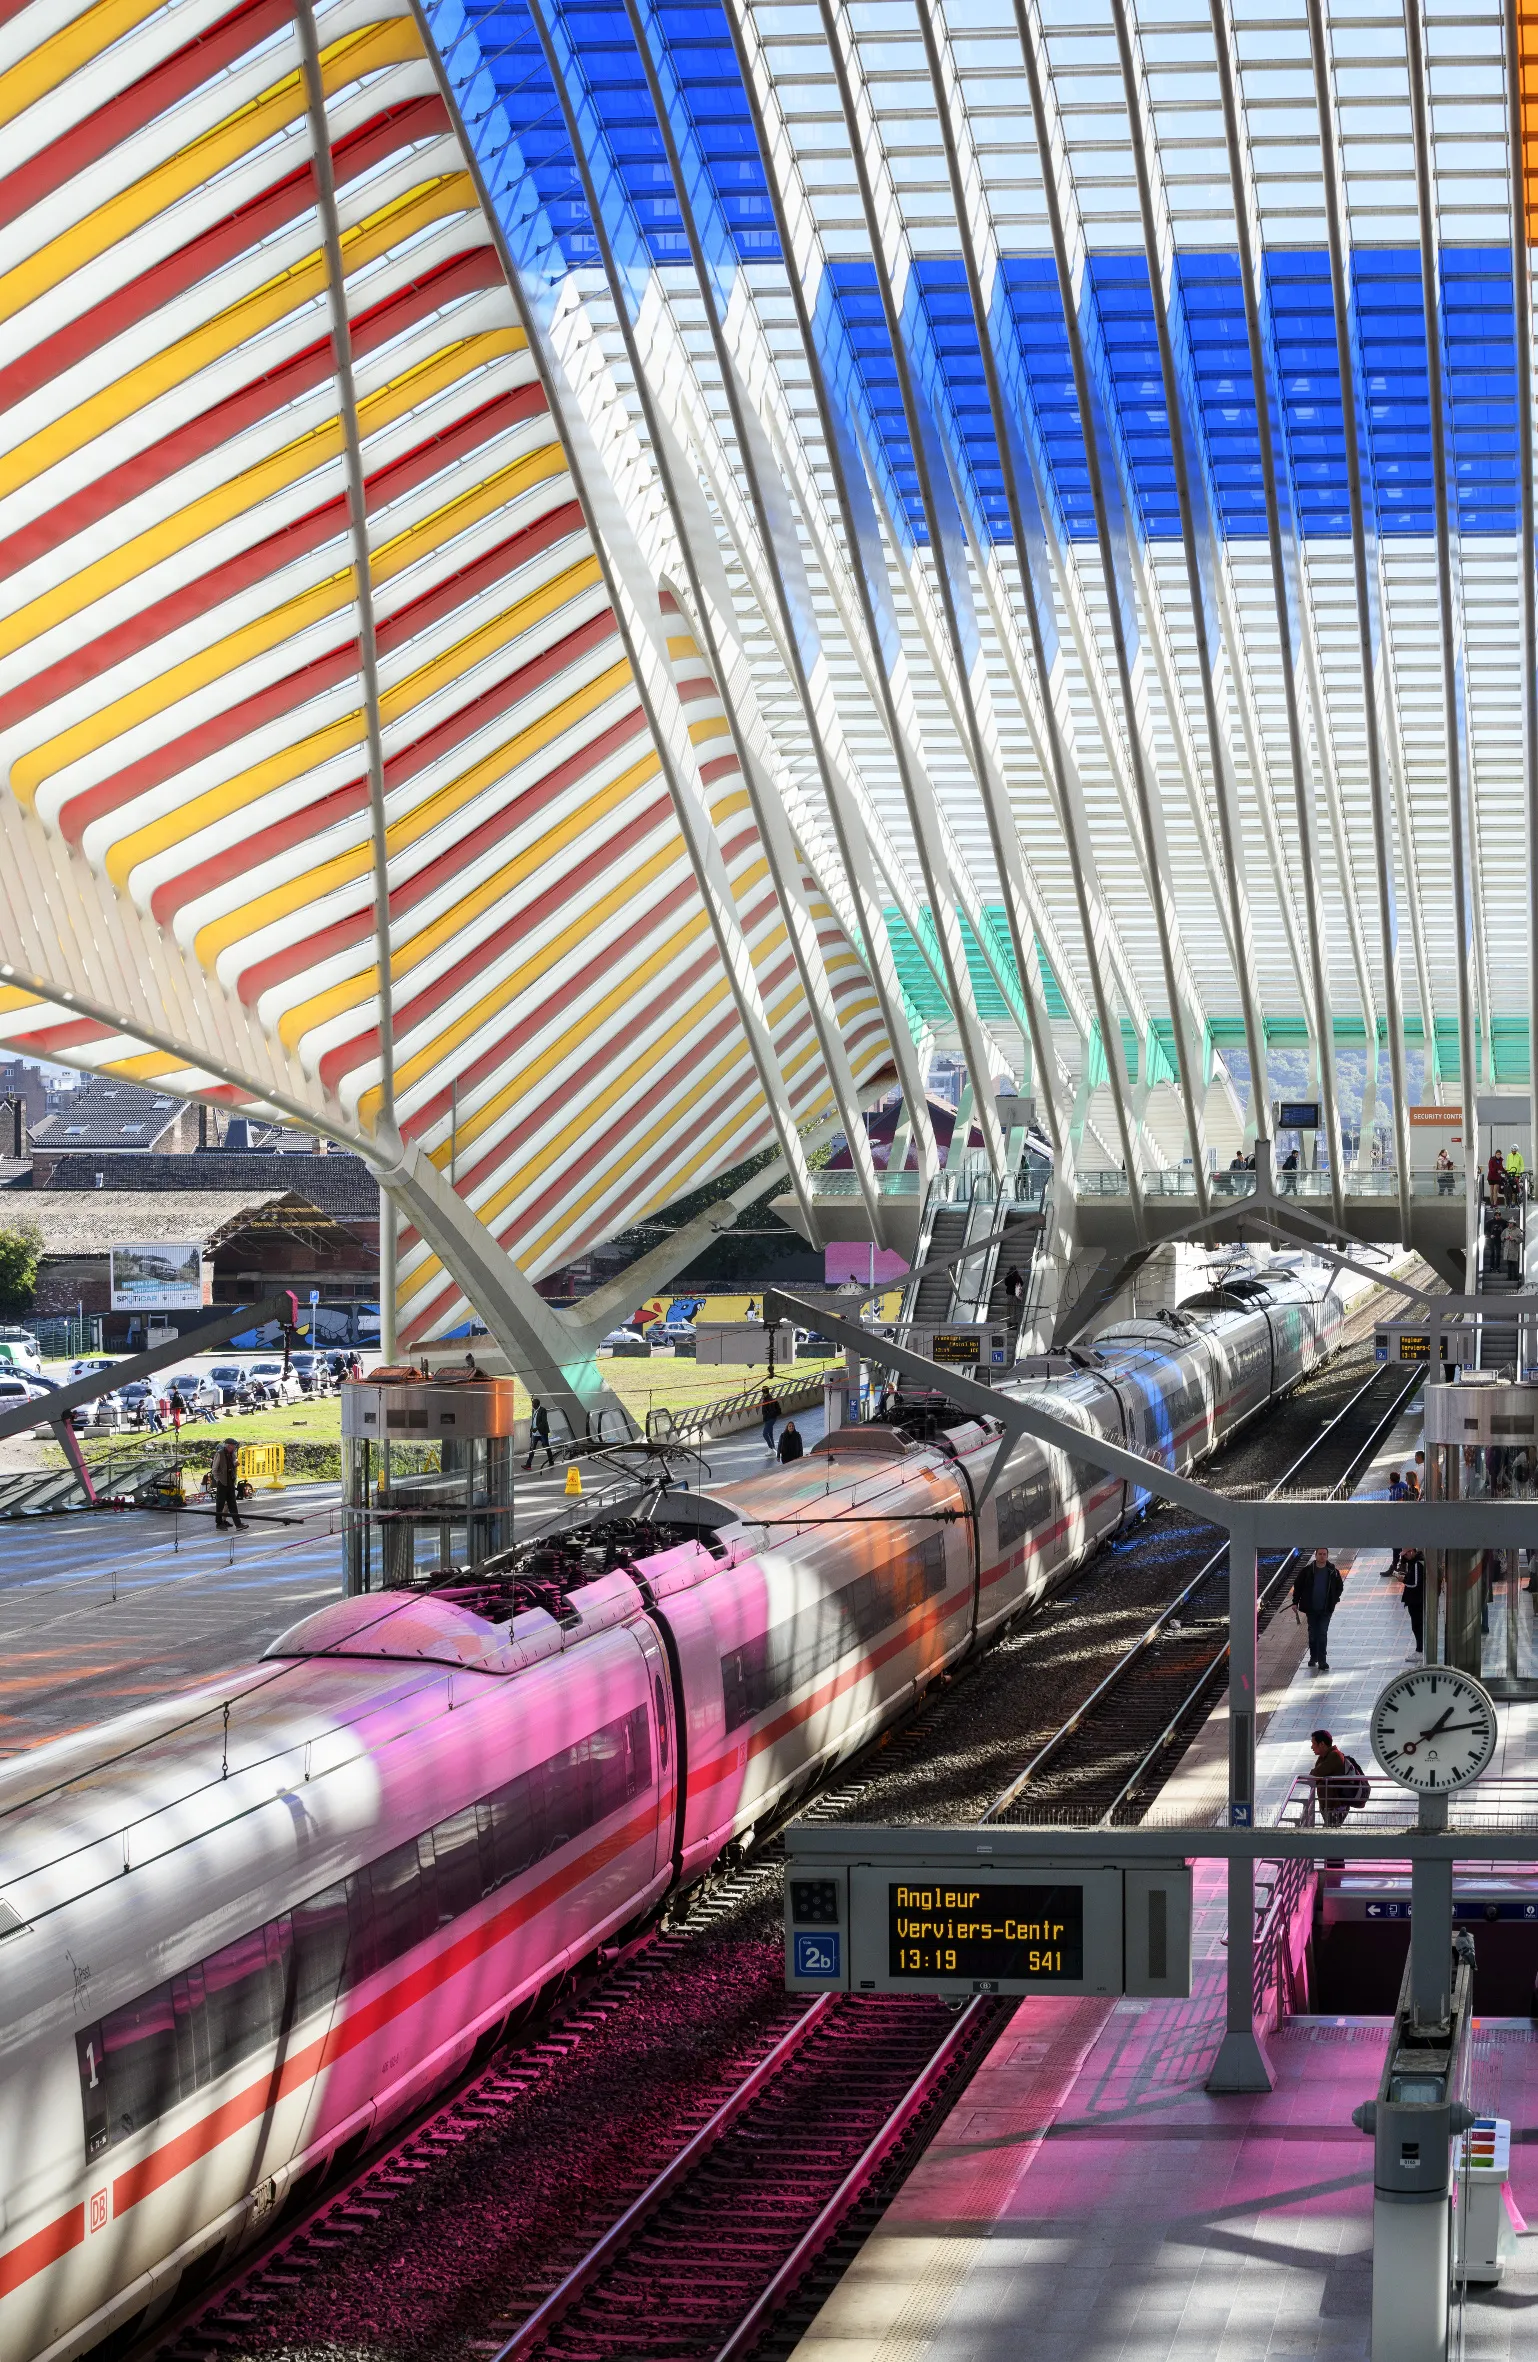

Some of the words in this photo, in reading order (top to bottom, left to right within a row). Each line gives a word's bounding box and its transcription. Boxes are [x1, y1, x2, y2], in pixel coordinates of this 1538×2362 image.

[736, 1655, 743, 1682] 2
[624, 1724, 632, 1755] 1
[898, 1888, 980, 1910] Angleur
[898, 1919, 1064, 1940] Verviers-Centr
[805, 1947, 831, 1969] 2b
[900, 1950, 956, 1970] 13:19
[1030, 1951, 1061, 1971] S41
[86, 2041, 99, 2089] 1
[92, 2192, 106, 2230] DB
